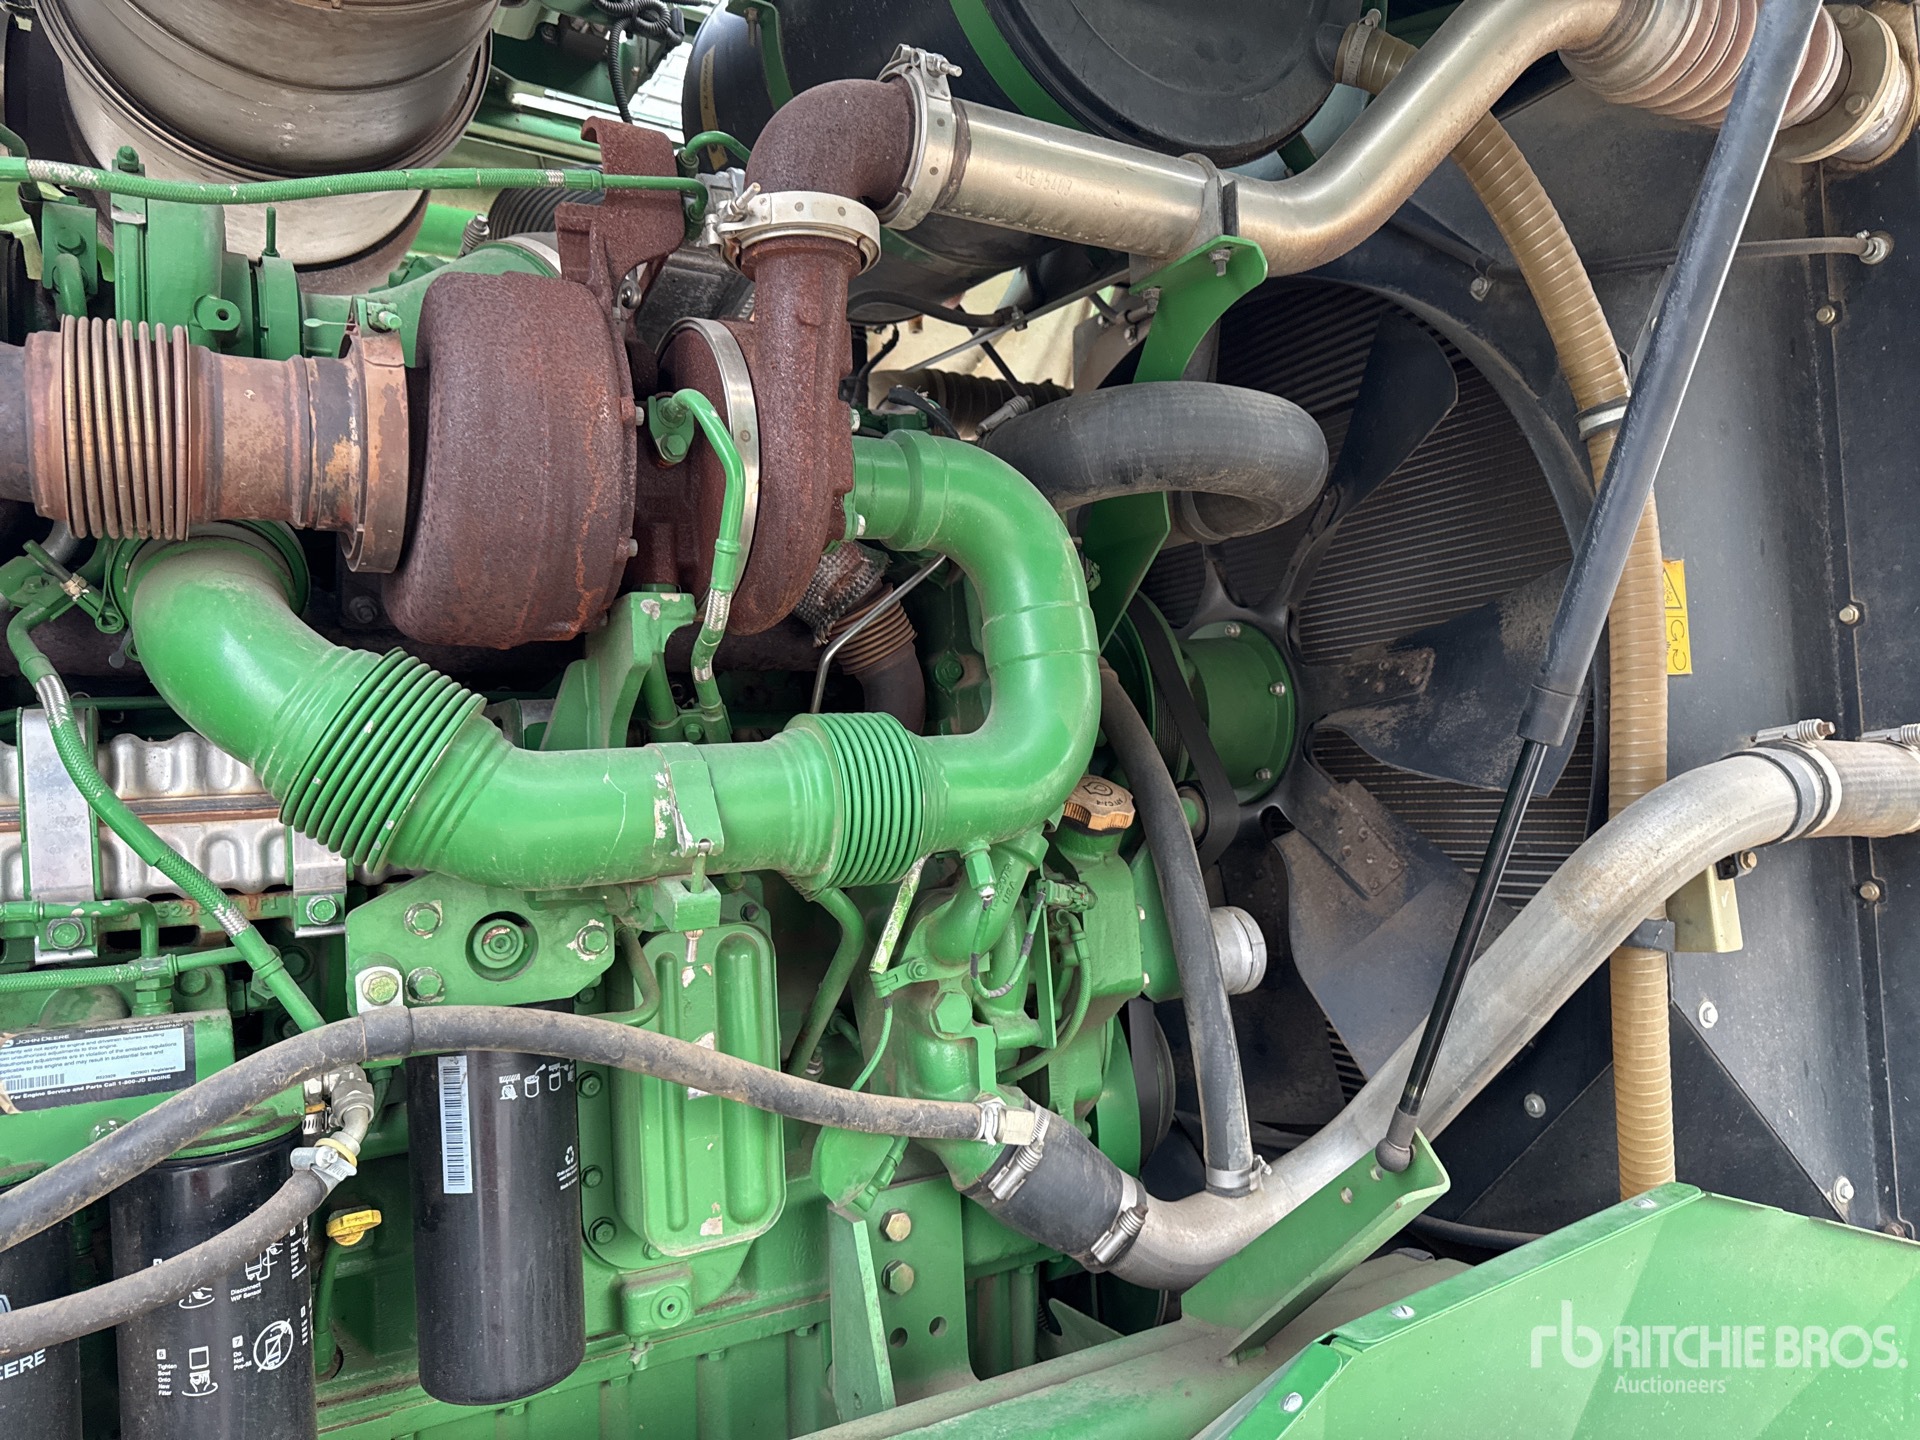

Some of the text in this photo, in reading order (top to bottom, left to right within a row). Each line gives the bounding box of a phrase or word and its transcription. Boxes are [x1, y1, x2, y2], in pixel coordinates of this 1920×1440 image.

[41, 1034, 70, 1042] DEERE
[23, 1090, 45, 1099] Engine
[47, 1088, 71, 1096] Service
[118, 1078, 146, 1086] 1-800-JD
[147, 1074, 171, 1082] ENGINE
[230, 1281, 262, 1296] Disconnect
[0, 1348, 46, 1380] ERE
[157, 1363, 178, 1371] Tighten
